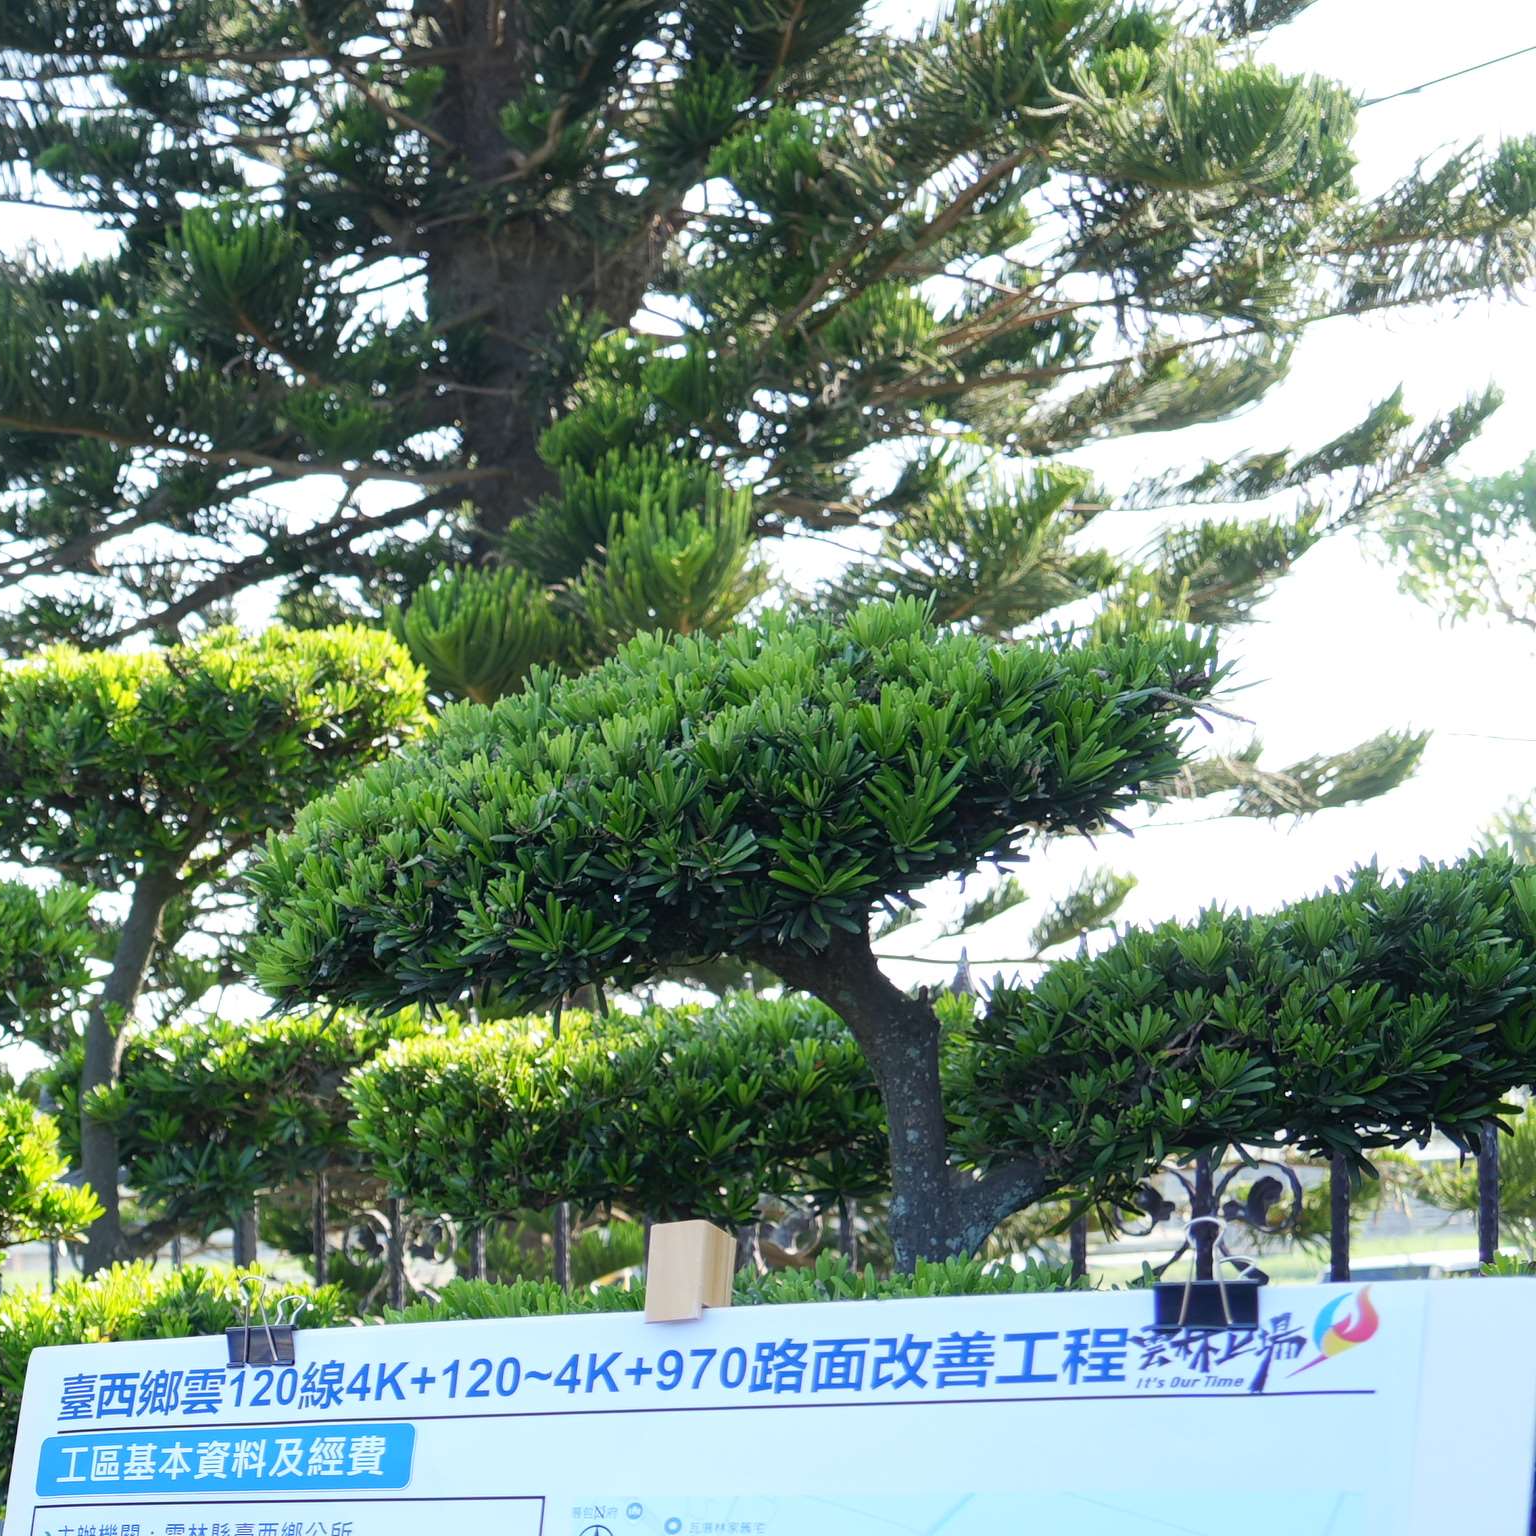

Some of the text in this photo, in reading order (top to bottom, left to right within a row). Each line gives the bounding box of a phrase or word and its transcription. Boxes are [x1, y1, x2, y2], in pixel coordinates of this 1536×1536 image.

[57, 1327, 1129, 1421] 臺西鄉雲120線4K+120~4K+970路面改善工程
[1136, 1375, 1245, 1389] It's Our Time
[56, 1435, 386, 1483] 工區基本資料及經費
